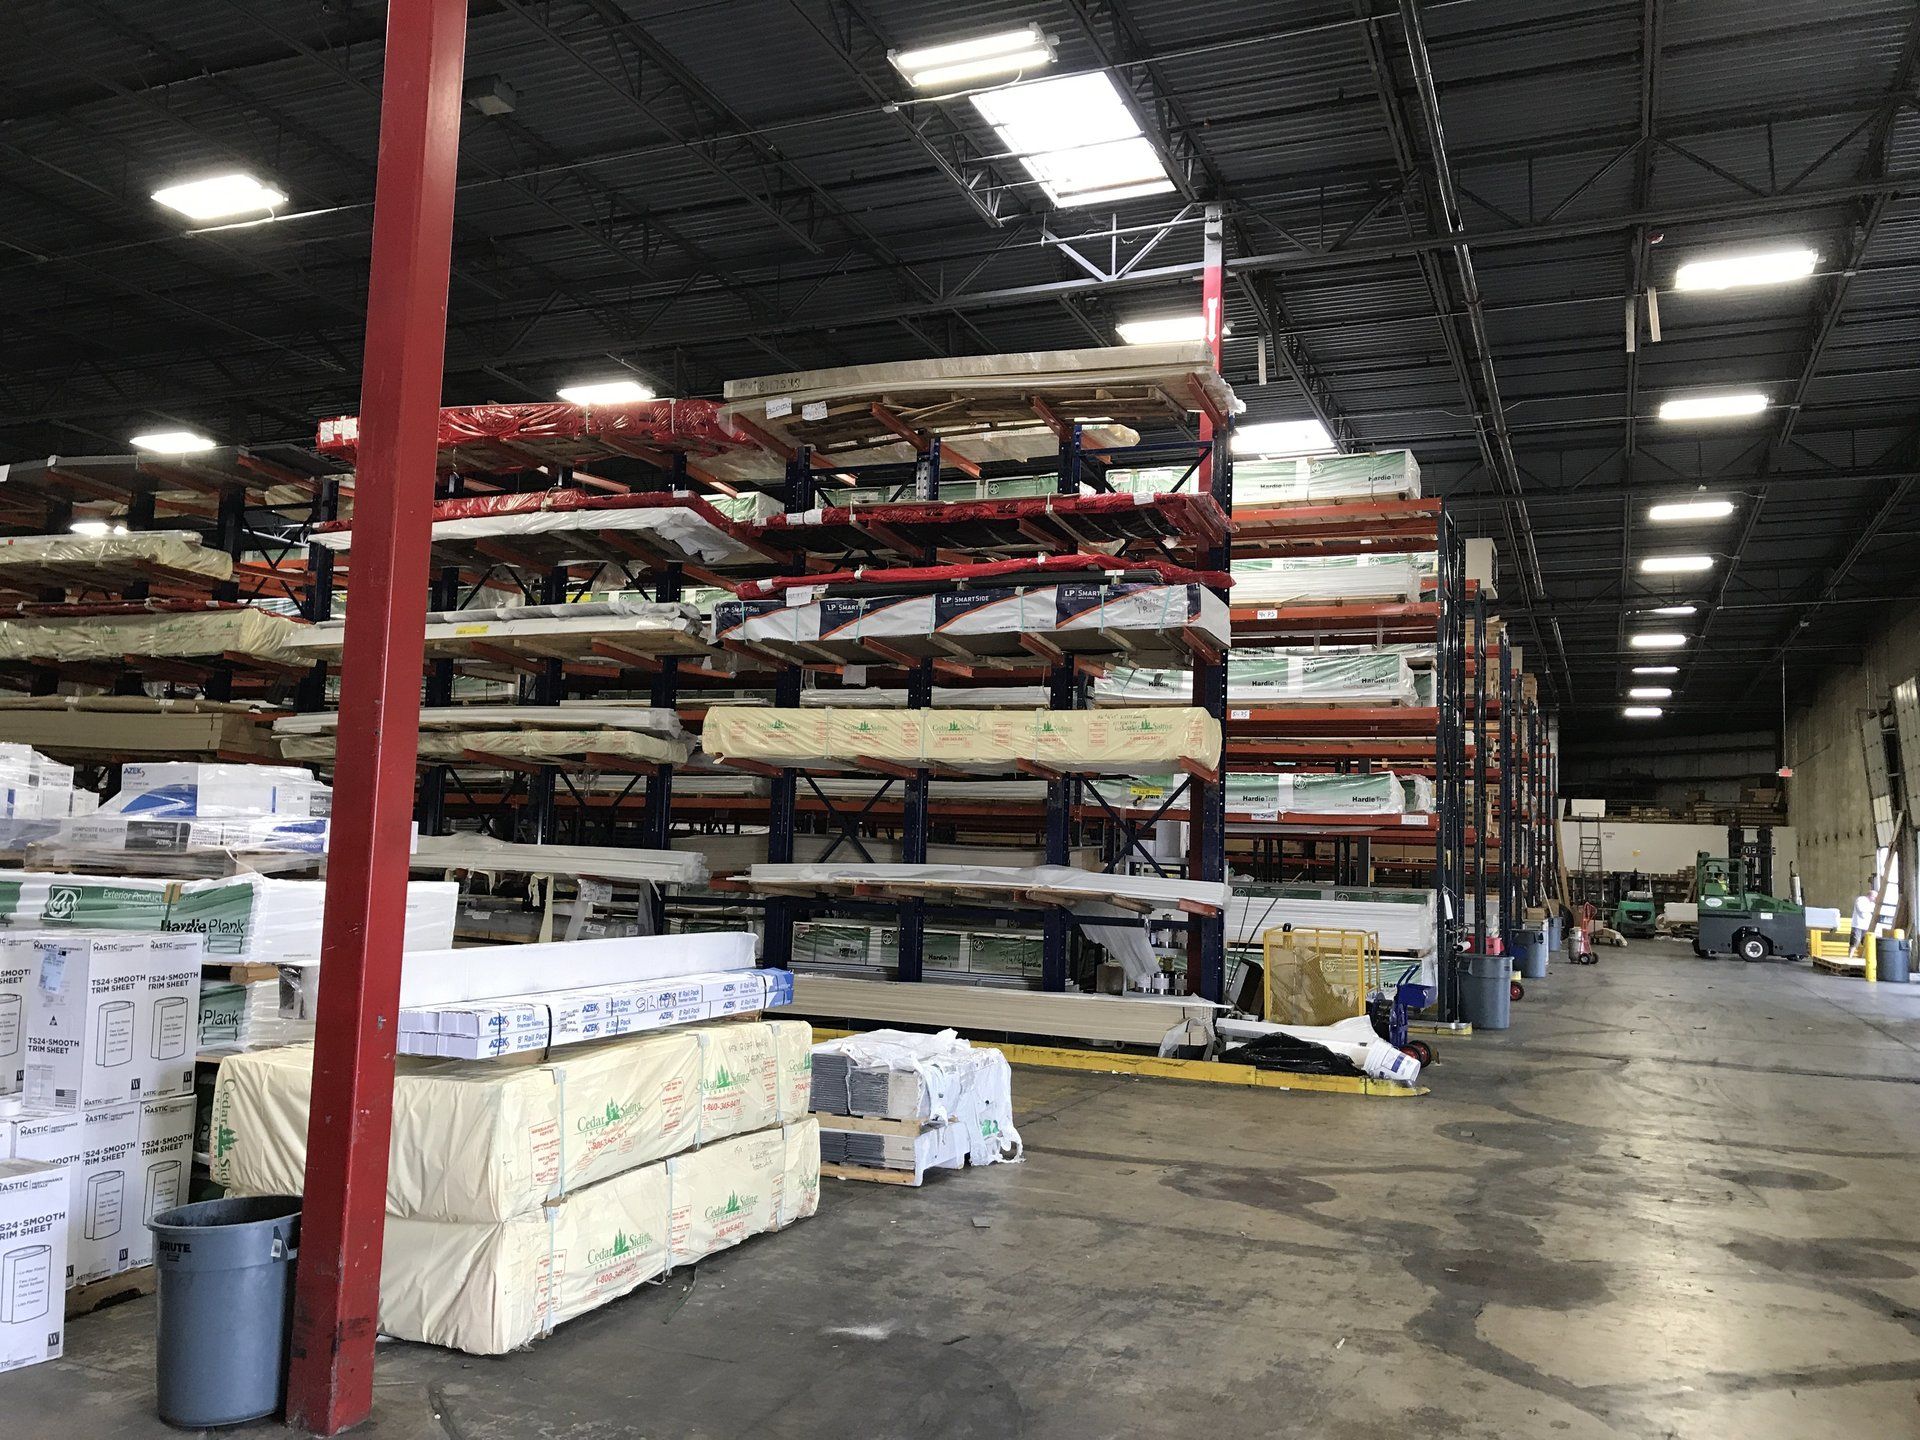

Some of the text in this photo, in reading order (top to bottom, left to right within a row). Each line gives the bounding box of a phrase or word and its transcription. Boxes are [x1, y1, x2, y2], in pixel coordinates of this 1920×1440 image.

[124, 767, 142, 775] AZEK
[102, 888, 132, 900] Exterior
[208, 919, 245, 934] Plank
[93, 943, 118, 952] MASTIC
[92, 983, 135, 994] TRIM SHEET
[166, 980, 189, 988] SHEET
[582, 1003, 599, 1014] AZEK
[202, 1010, 239, 1026] Plank
[488, 1015, 508, 1026] AZEK
[659, 1011, 672, 1020] AZEK
[582, 1023, 599, 1034] AZEK
[488, 1037, 508, 1048] AZEK
[524, 1034, 535, 1042] Rail
[536, 1032, 548, 1040] Pack
[47, 1046, 69, 1054] SHEET
[222, 1078, 236, 1125] Cedar
[144, 1105, 168, 1114] MASTIC
[577, 1116, 606, 1132] Cedar
[20, 1125, 48, 1136] MASTIC
[141, 1142, 183, 1157] TRIM SHEET
[101, 1152, 126, 1163] SHEET
[704, 1204, 727, 1219] Cedar
[0, 1223, 52, 1240] RIM SHEET
[160, 1241, 192, 1253] BRUTE
[588, 1248, 613, 1264] Cedar
